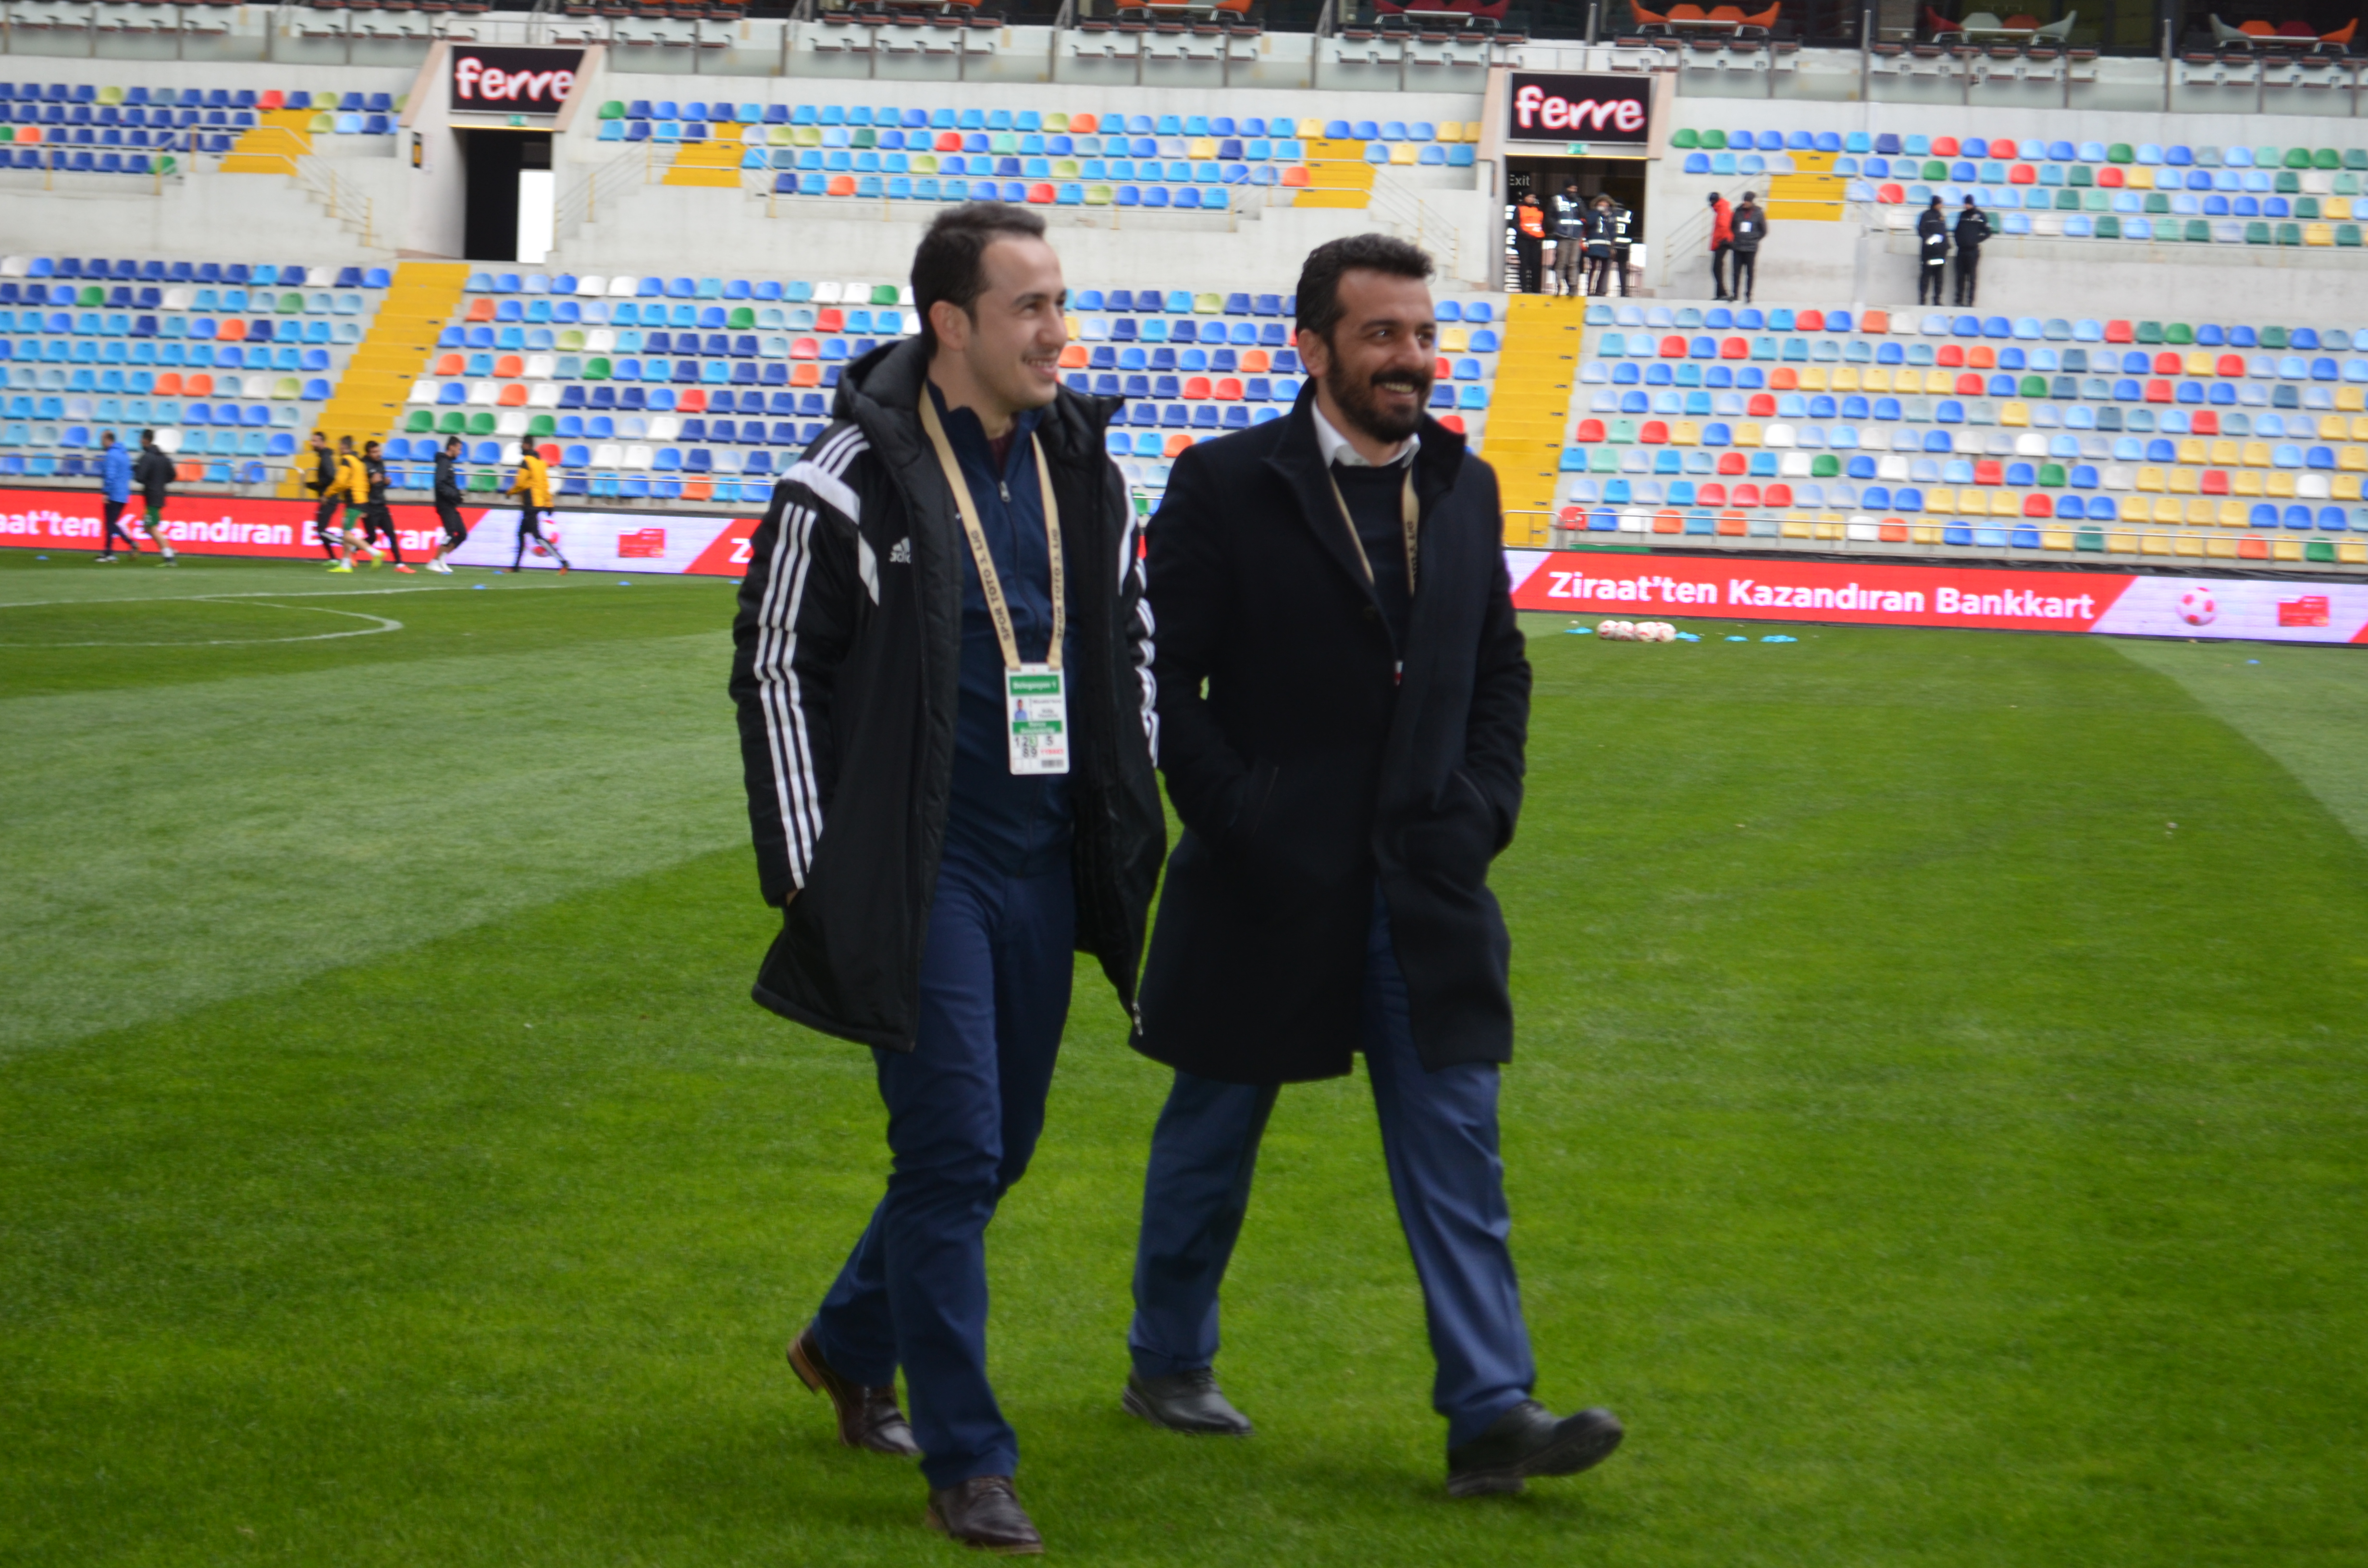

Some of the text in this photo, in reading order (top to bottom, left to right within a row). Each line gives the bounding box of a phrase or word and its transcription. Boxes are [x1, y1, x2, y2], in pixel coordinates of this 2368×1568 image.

[455, 56, 575, 102] ferre
[1515, 85, 1645, 132] ferre
[1509, 174, 1530, 186] Exit
[983, 569, 999, 603] TOTO
[1548, 572, 2095, 619] Ziraat'ten Kazandıran Bankkart
[995, 607, 1011, 642] SPOR
